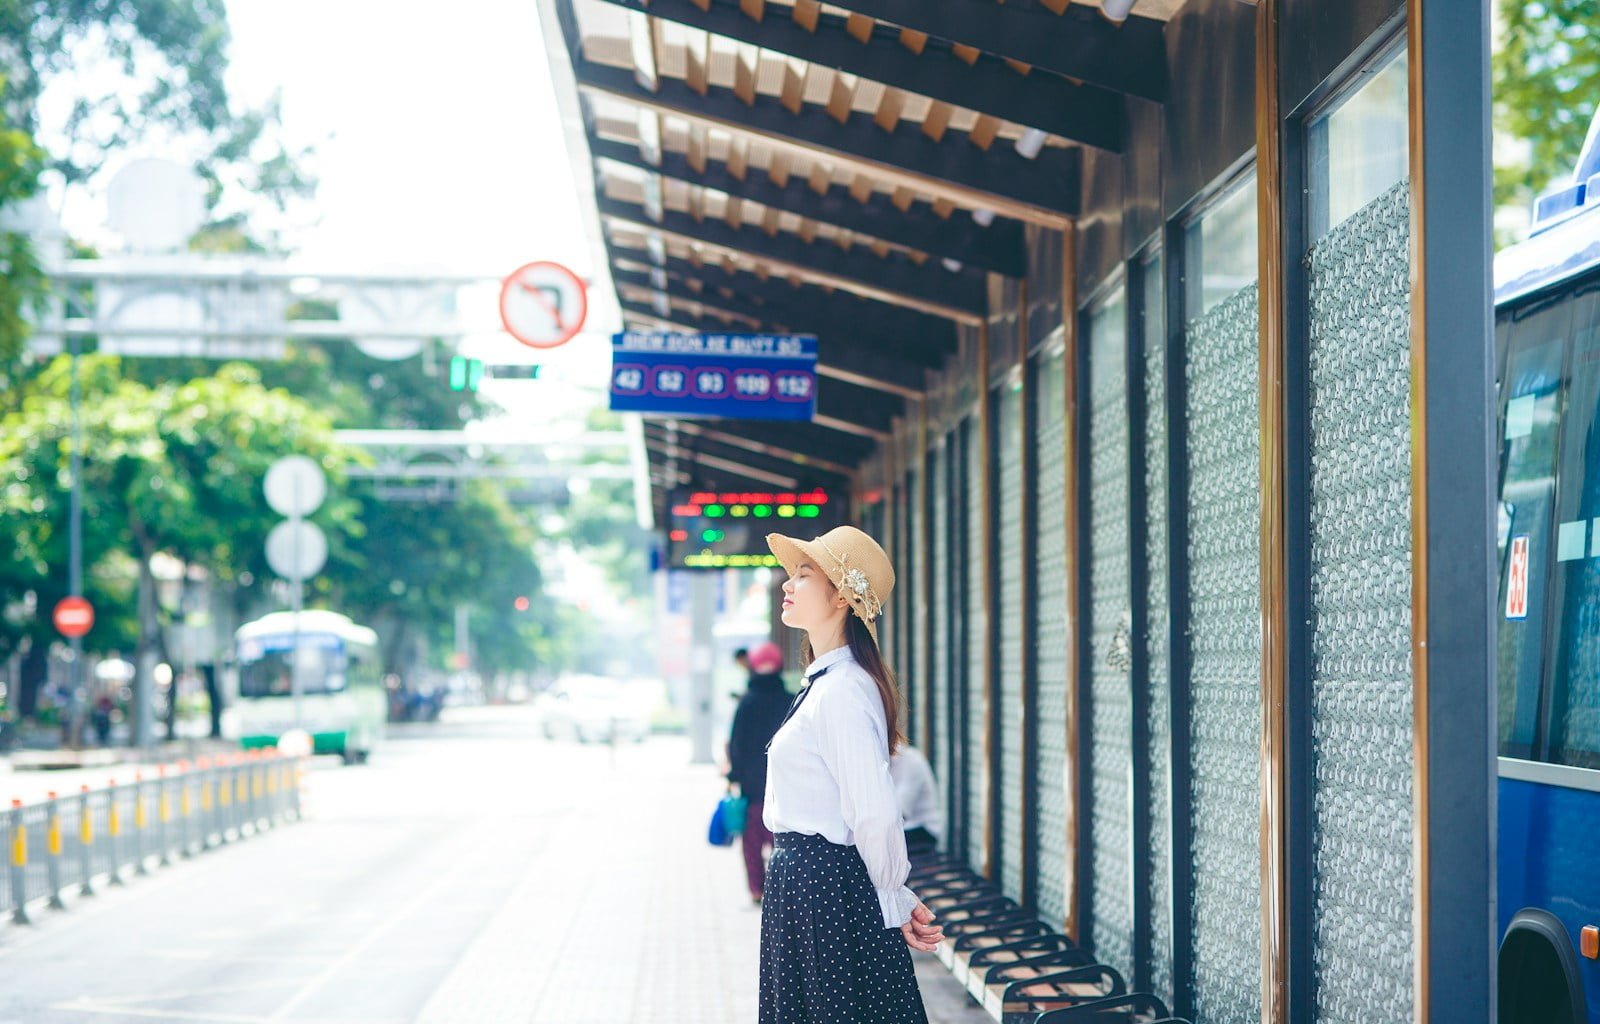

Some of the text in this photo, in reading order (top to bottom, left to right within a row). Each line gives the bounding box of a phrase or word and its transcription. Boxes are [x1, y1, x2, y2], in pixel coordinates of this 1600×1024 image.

[615, 368, 642, 390] 42
[657, 370, 684, 392] 52
[698, 371, 724, 393] 93
[776, 375, 811, 397] 152
[1510, 540, 1527, 615] 53
